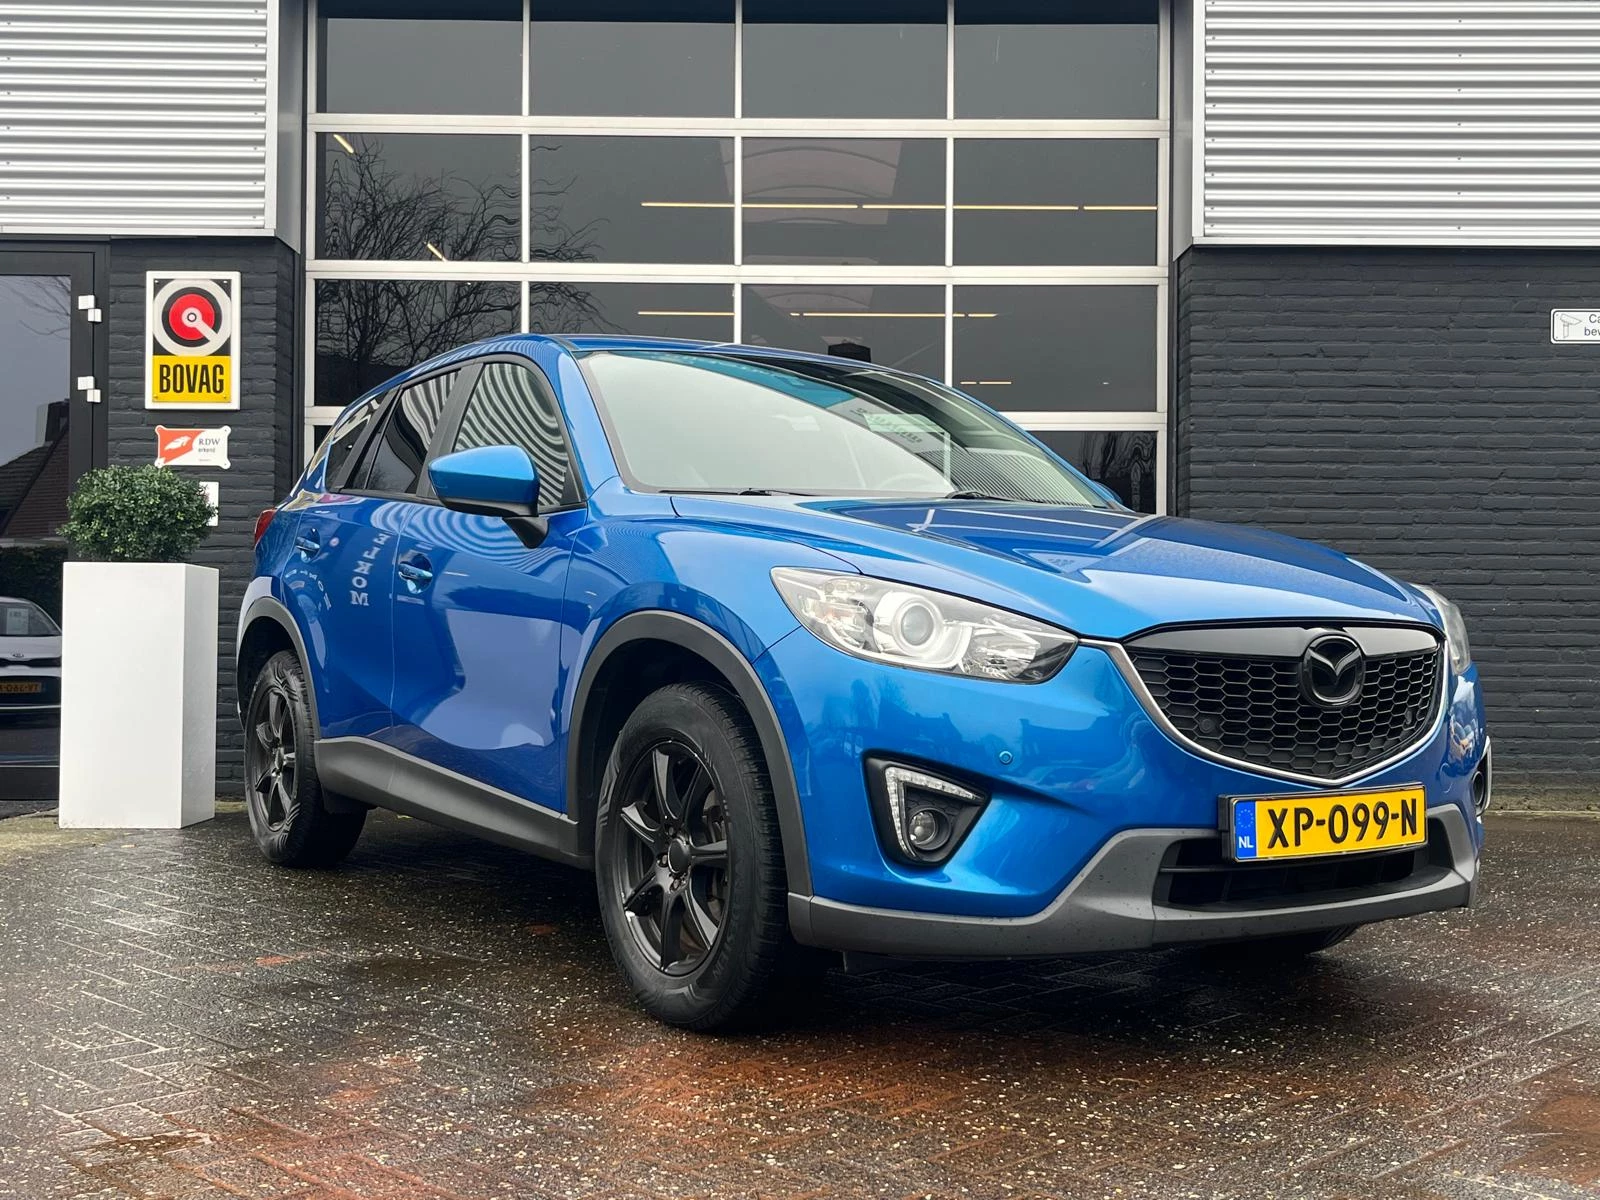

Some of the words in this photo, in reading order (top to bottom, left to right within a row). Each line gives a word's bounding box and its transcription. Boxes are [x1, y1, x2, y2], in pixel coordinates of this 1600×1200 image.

[159, 364, 224, 394] BOVAG
[198, 438, 221, 446] RDW
[1267, 798, 1417, 849] XP-099-N
[1238, 835, 1254, 848] NL
